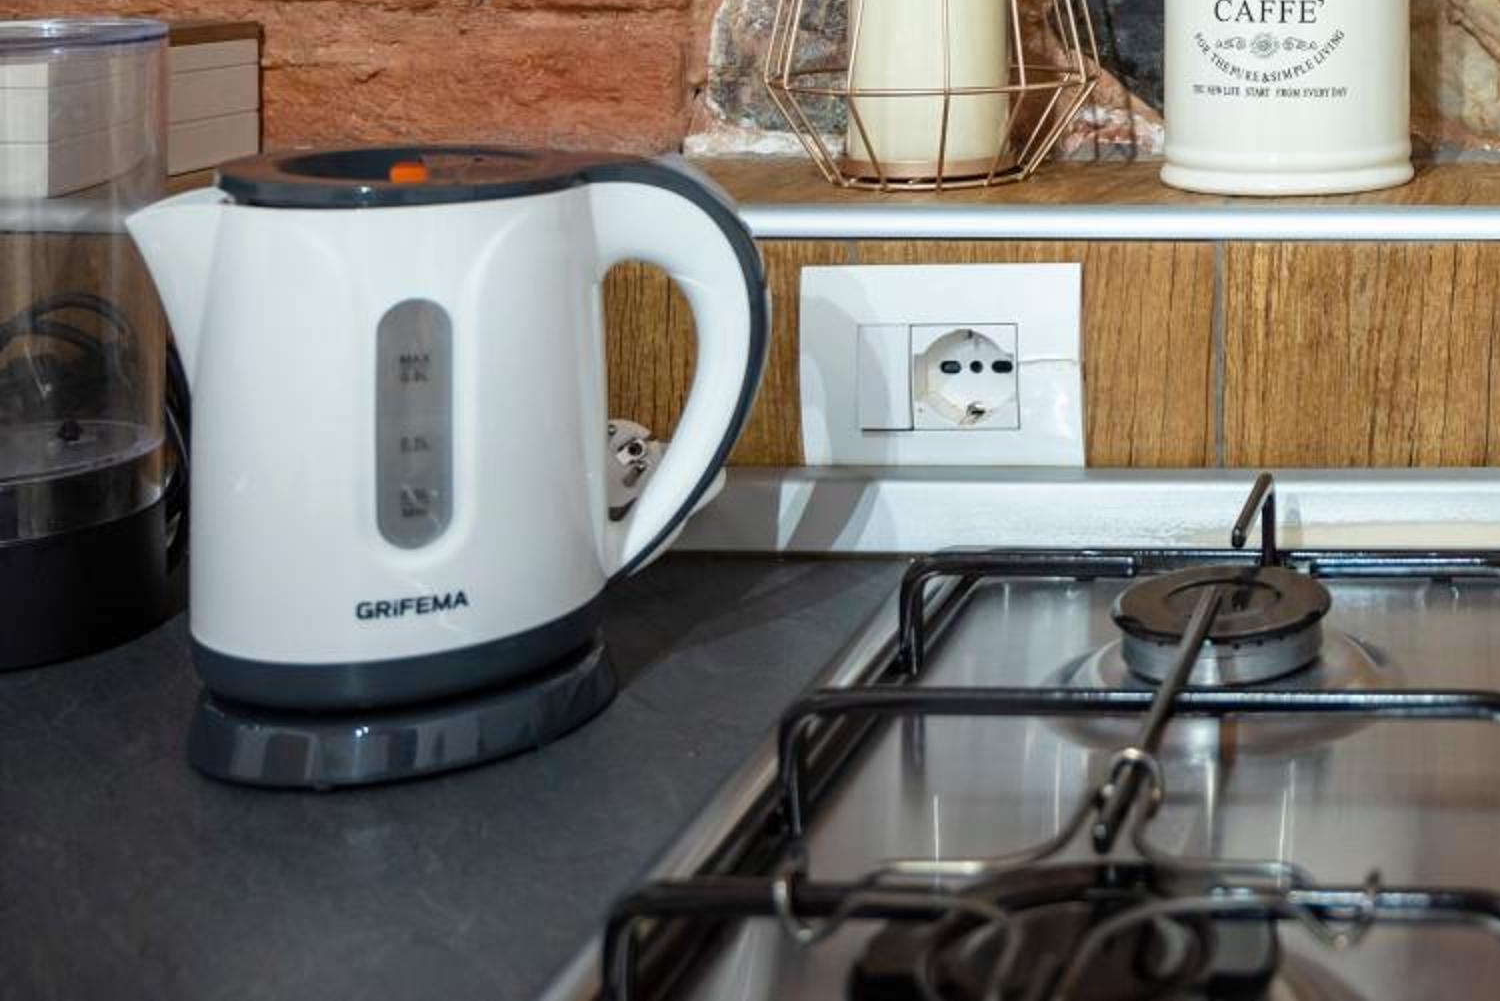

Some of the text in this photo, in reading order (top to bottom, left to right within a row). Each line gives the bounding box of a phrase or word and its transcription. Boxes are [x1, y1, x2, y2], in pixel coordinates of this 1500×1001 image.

[1210, 52, 1230, 73] THE
[1229, 64, 1259, 82] PURE
[1313, 29, 1345, 65] LIVING
